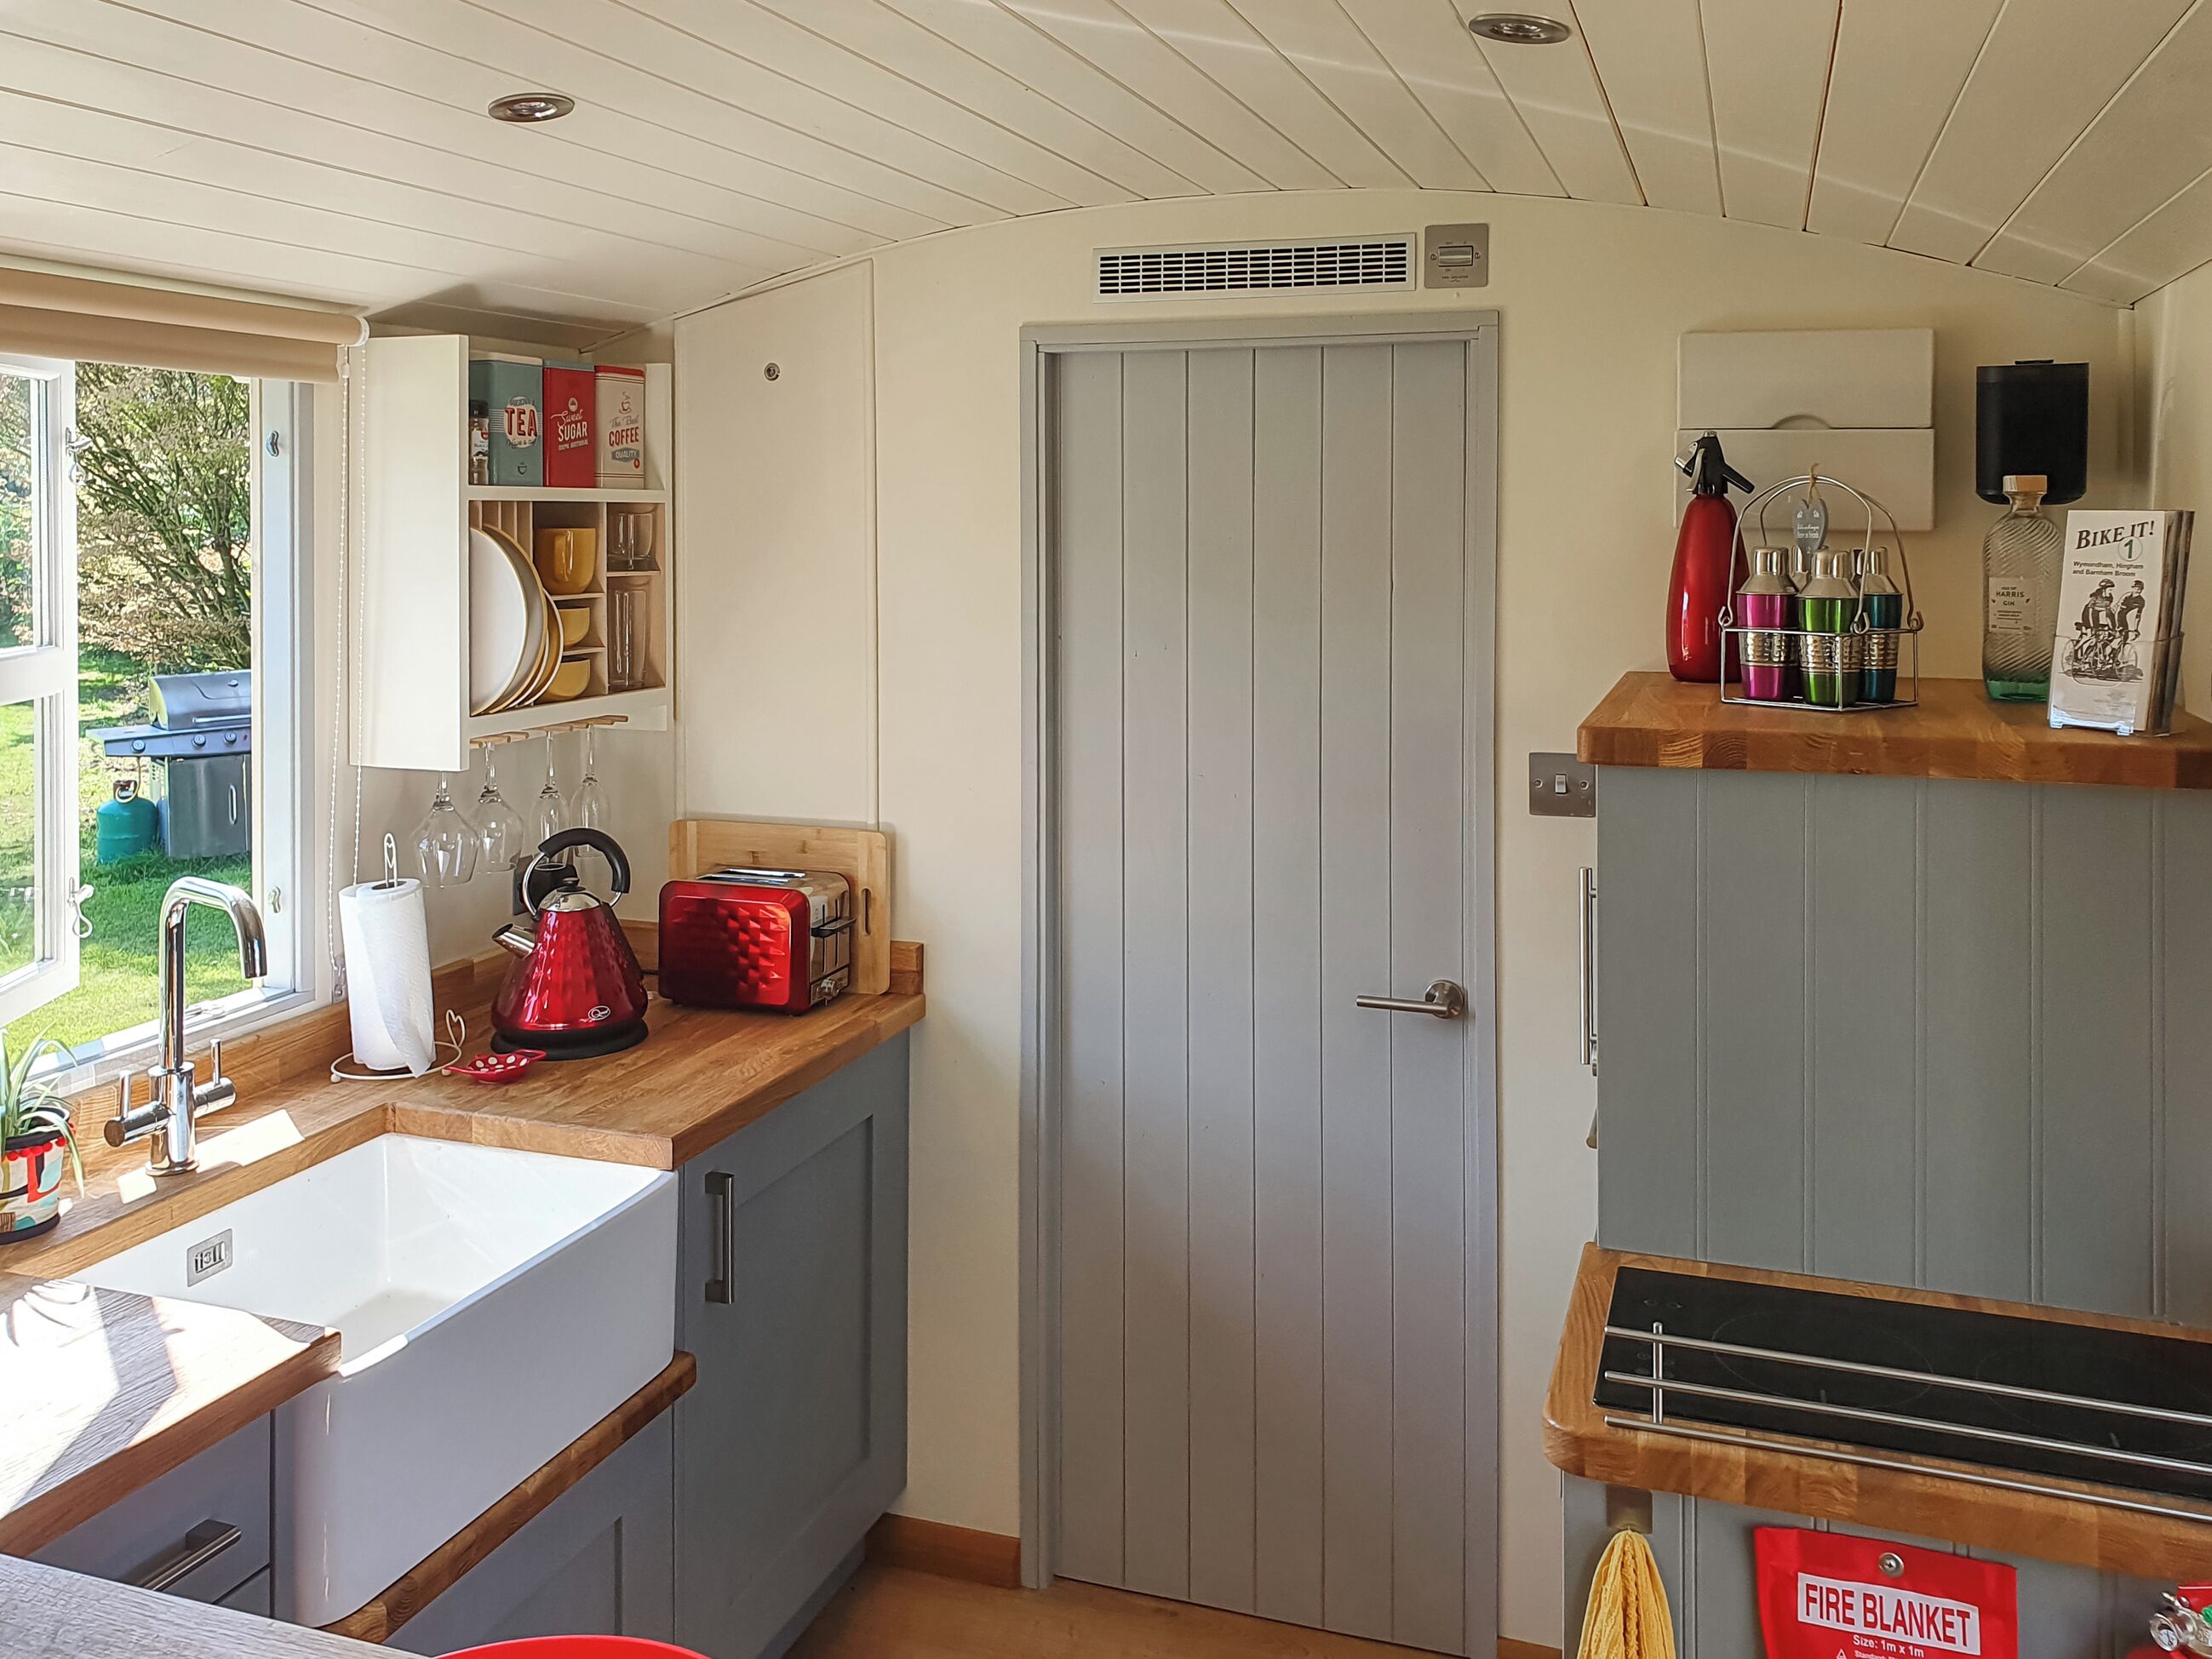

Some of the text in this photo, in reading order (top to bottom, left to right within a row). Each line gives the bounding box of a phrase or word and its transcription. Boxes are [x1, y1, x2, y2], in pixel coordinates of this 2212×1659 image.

[505, 408, 537, 437] TEA
[551, 409, 583, 427] Sweet
[558, 421, 587, 442] SUGAR
[609, 426, 639, 447] COFFEE
[615, 449, 638, 459] QUALITY
[2130, 520, 2154, 538] IT!
[2124, 539, 2134, 559] 1
[2073, 561, 2115, 569] Wymondham,
[1806, 1582, 1970, 1647] FIRE BLANKET
[1853, 1634, 1924, 1658] Size: 1m x 1m
